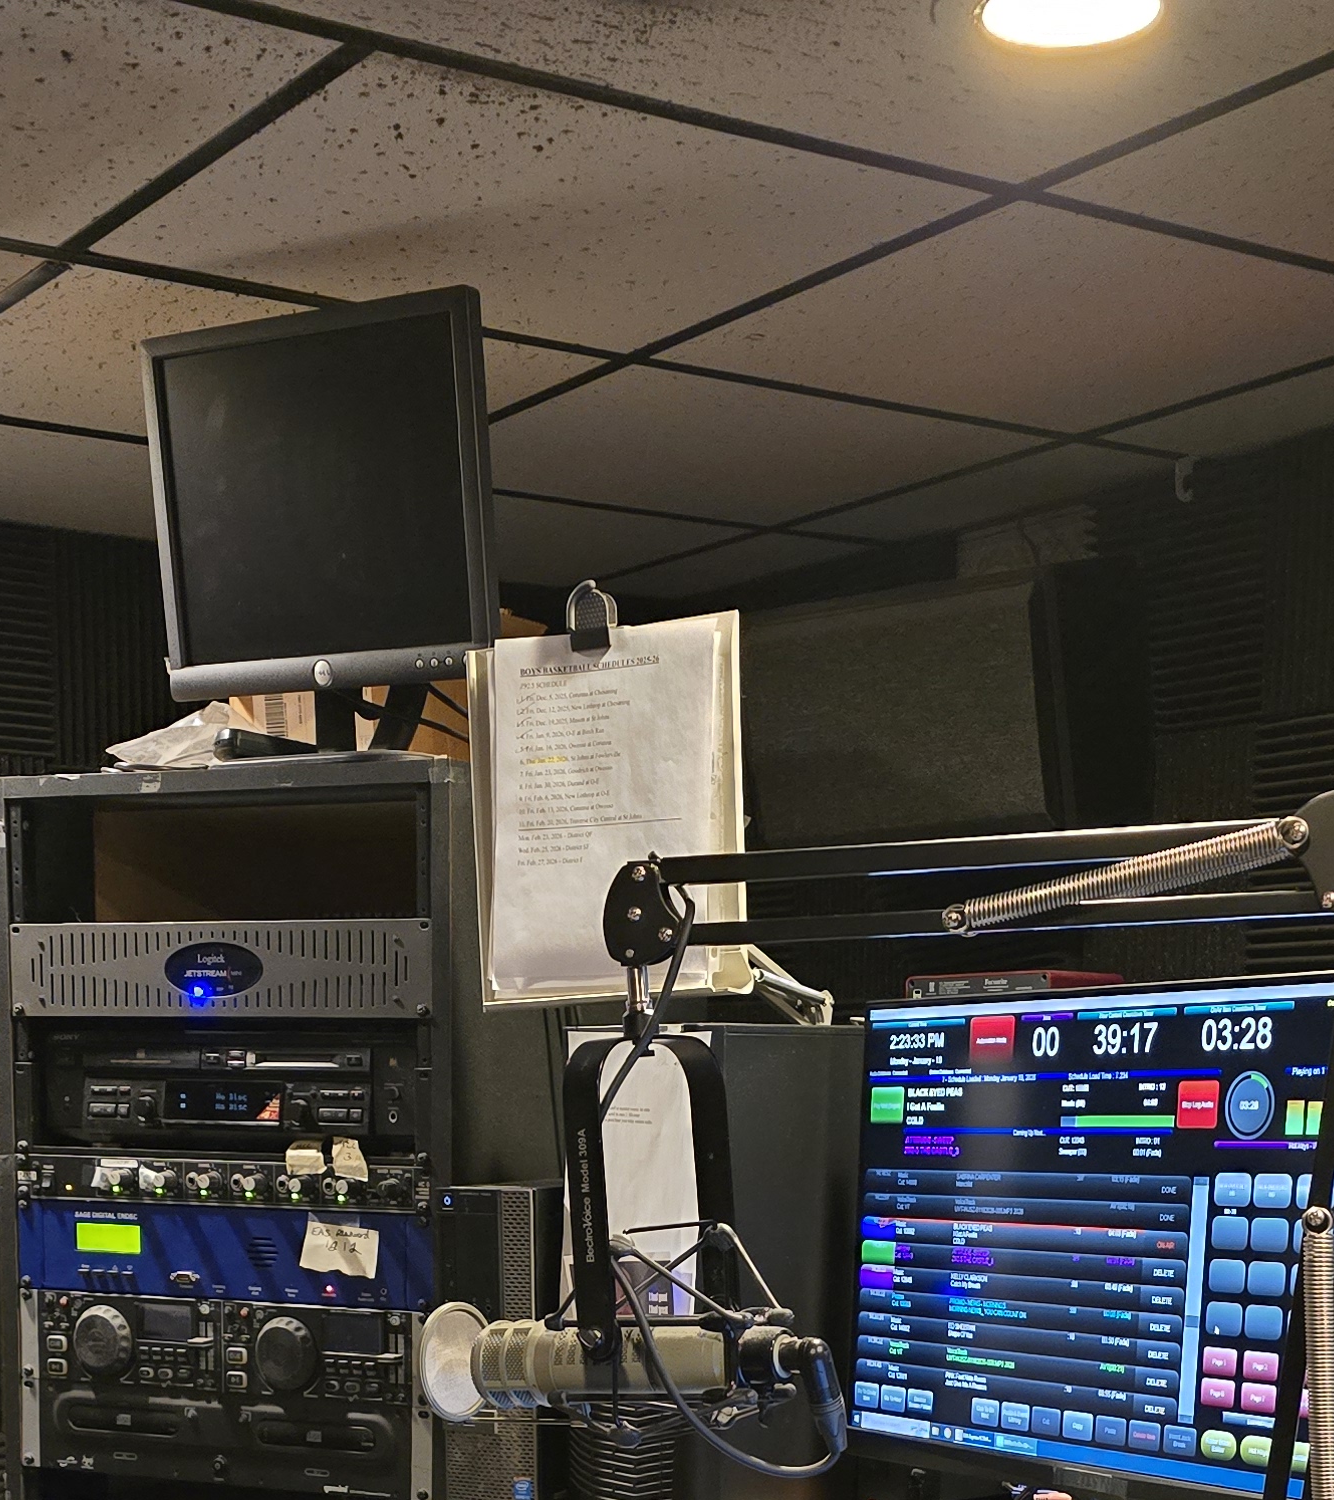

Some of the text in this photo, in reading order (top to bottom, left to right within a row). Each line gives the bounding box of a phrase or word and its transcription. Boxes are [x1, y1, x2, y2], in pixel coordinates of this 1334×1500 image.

[520, 666, 542, 676] BOYS
[543, 664, 591, 675] BASKETBALL
[592, 658, 635, 670] SCHEDULES
[184, 969, 227, 978] JETSTREAM
[890, 1016, 1273, 1057] 2:23:33 PM 00 39:17 03:28
[578, 1128, 590, 1194] Model 309A
[1161, 1186, 1177, 1194] DONE
[91, 1211, 115, 1220] DIGITAL
[1159, 1214, 1175, 1222] DONE
[1153, 1268, 1175, 1278] DELETE
[1151, 1295, 1173, 1306] DELETE
[1149, 1322, 1171, 1333] DELETE
